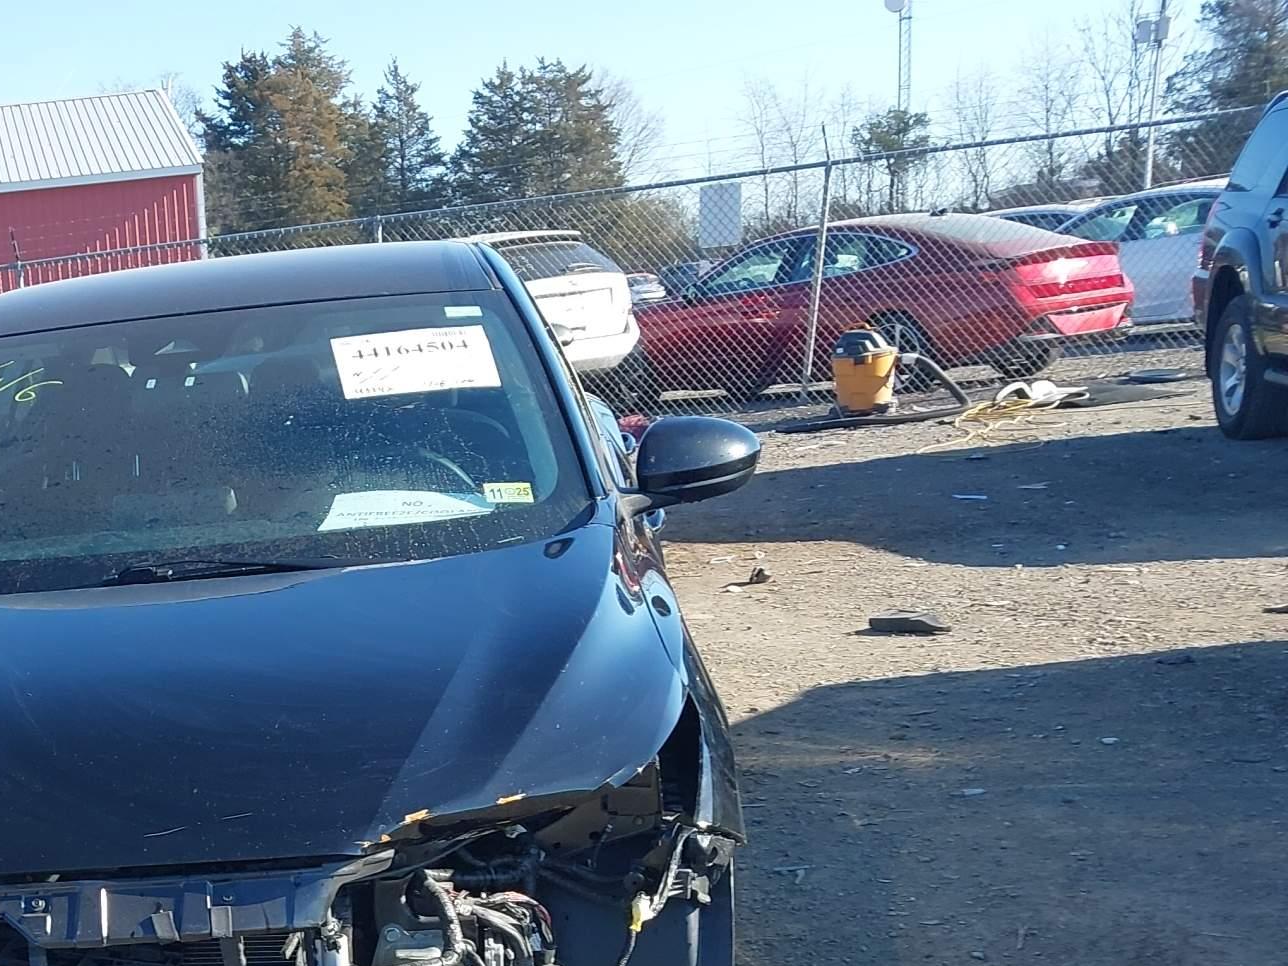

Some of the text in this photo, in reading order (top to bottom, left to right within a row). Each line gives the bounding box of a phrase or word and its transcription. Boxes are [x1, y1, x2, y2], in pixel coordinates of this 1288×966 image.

[352, 339, 469, 360] 44164504
[489, 487, 530, 500] 11 25
[336, 508, 478, 518] ANTIFREEZE/COOLA
